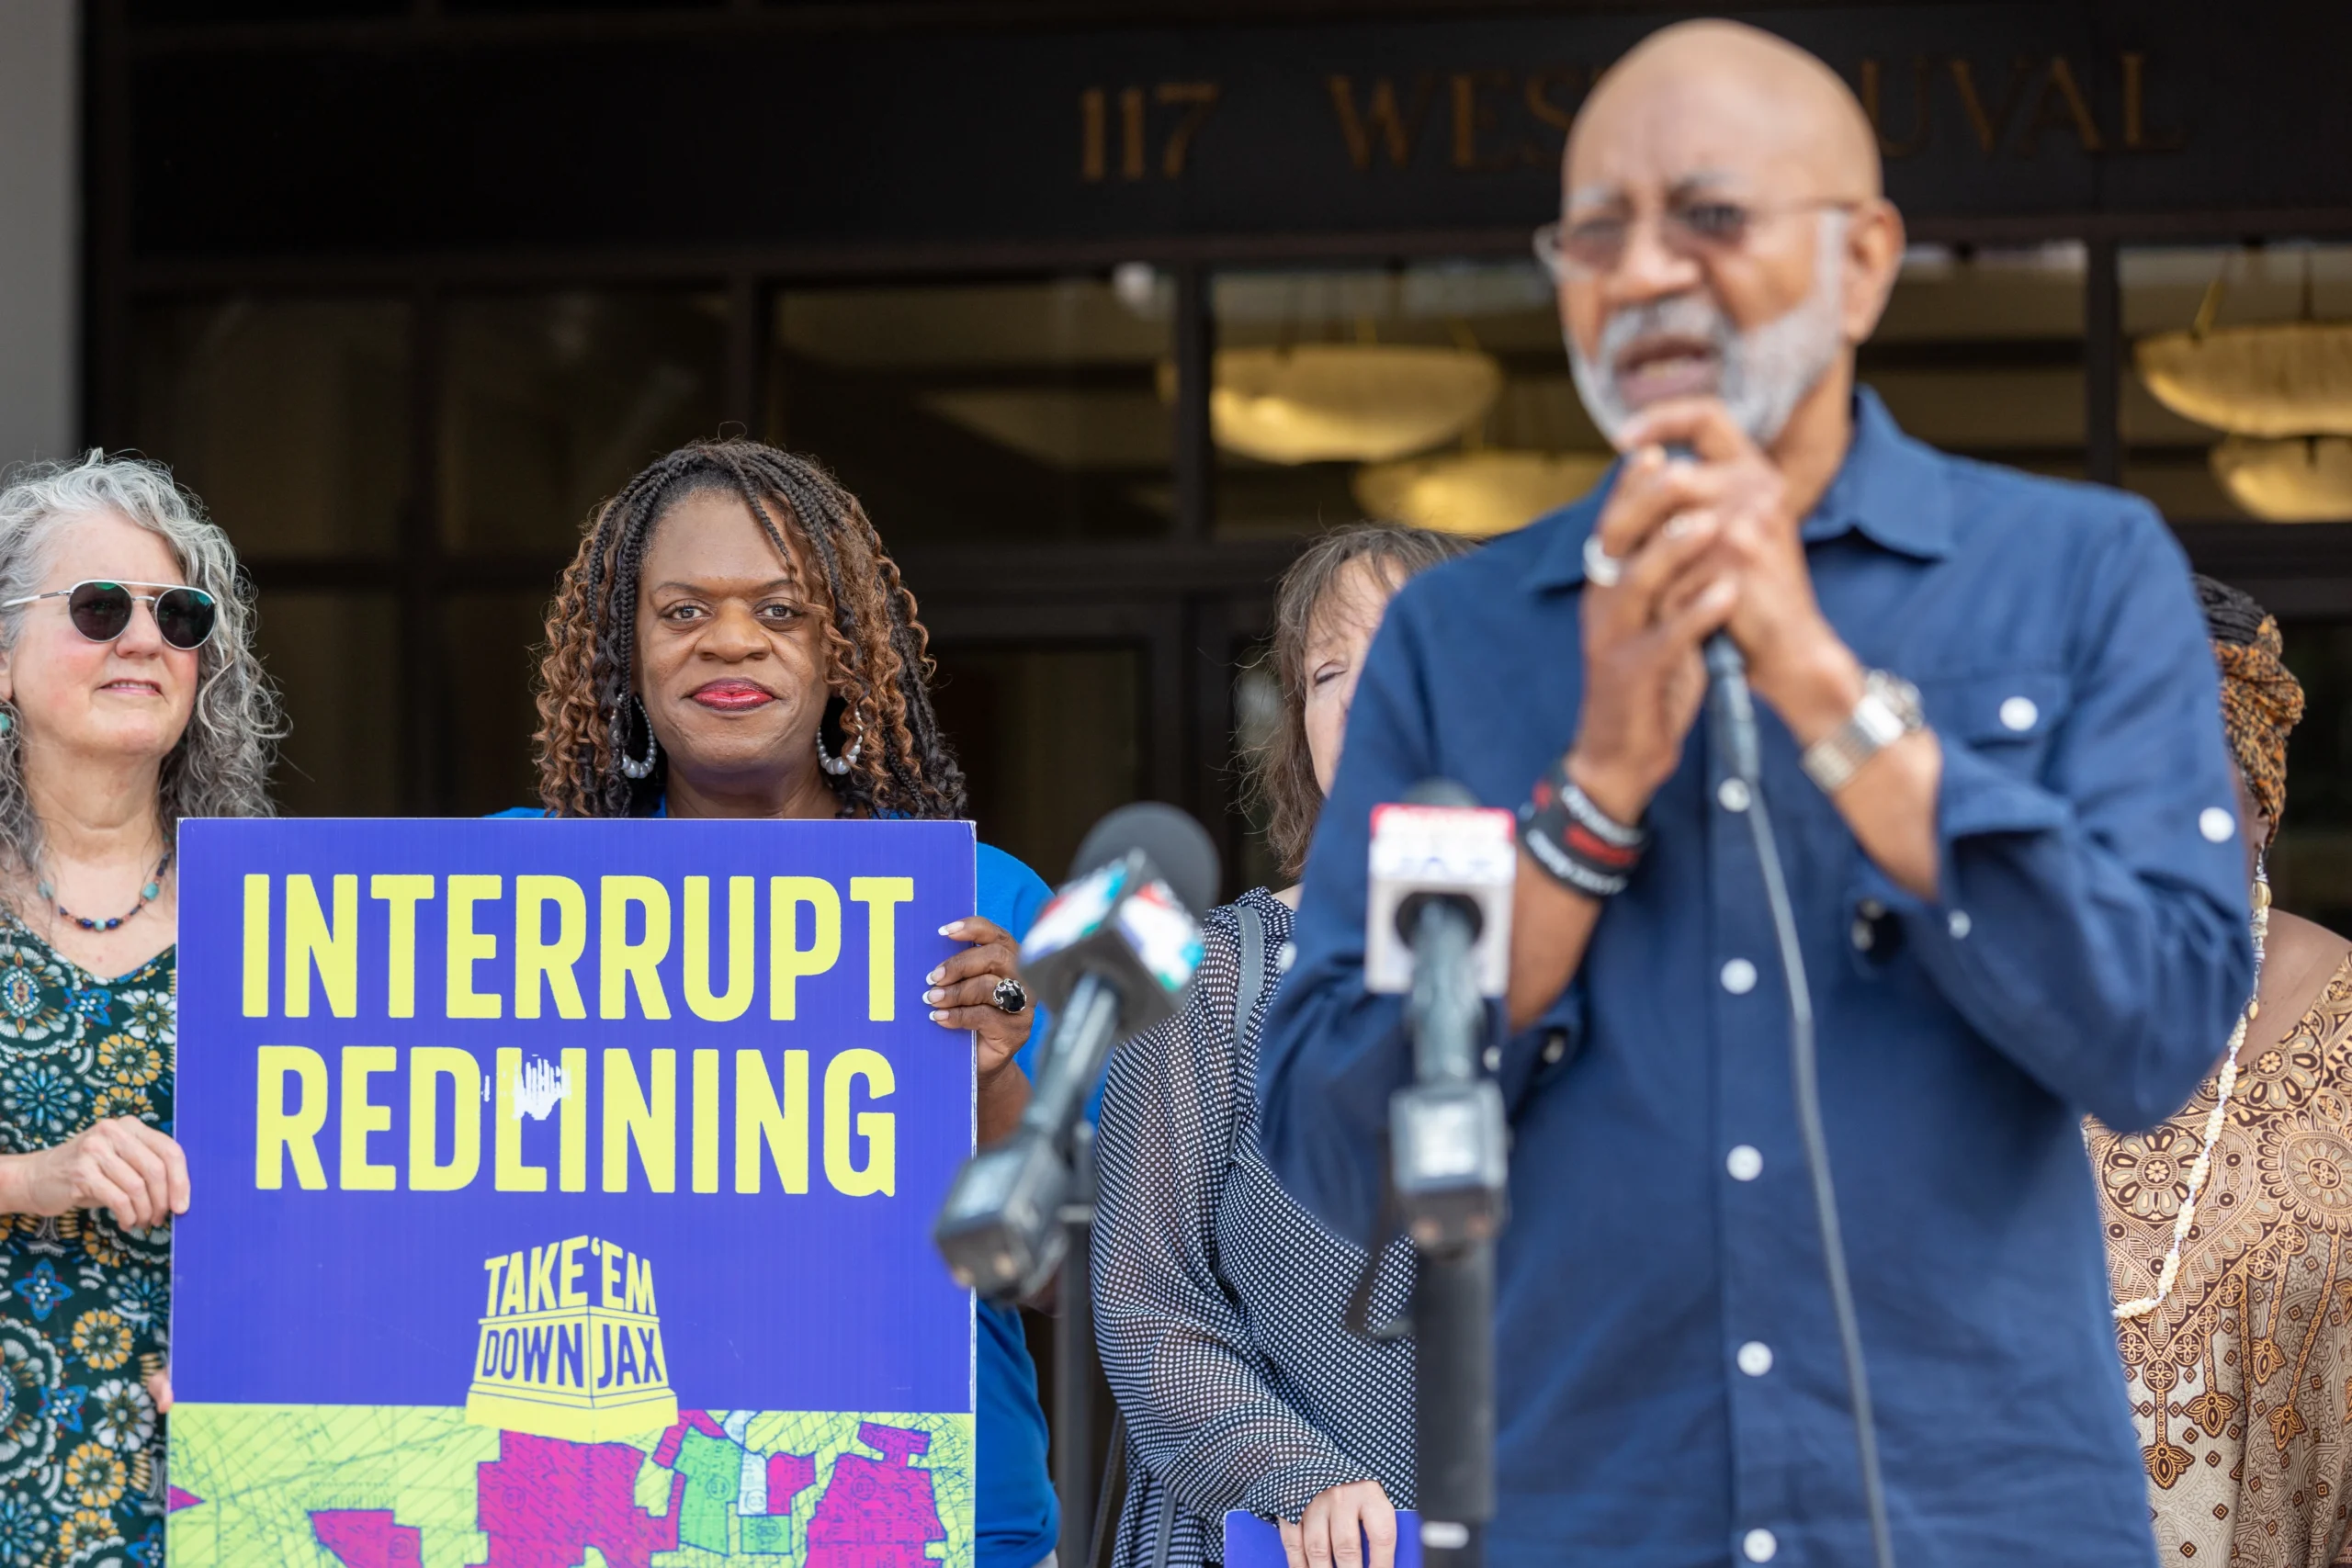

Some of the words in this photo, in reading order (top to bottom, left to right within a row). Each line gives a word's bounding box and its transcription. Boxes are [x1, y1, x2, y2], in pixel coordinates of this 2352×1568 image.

[1080, 82, 1219, 179] 117
[1325, 67, 1604, 172] WES
[1858, 51, 2188, 157] UVAL
[243, 874, 914, 1021] INTERRUPT
[255, 1045, 896, 1197] REDLINING
[484, 1235, 589, 1317] TAKE
[481, 1323, 584, 1388] DOWN
[597, 1323, 663, 1389] JAX
